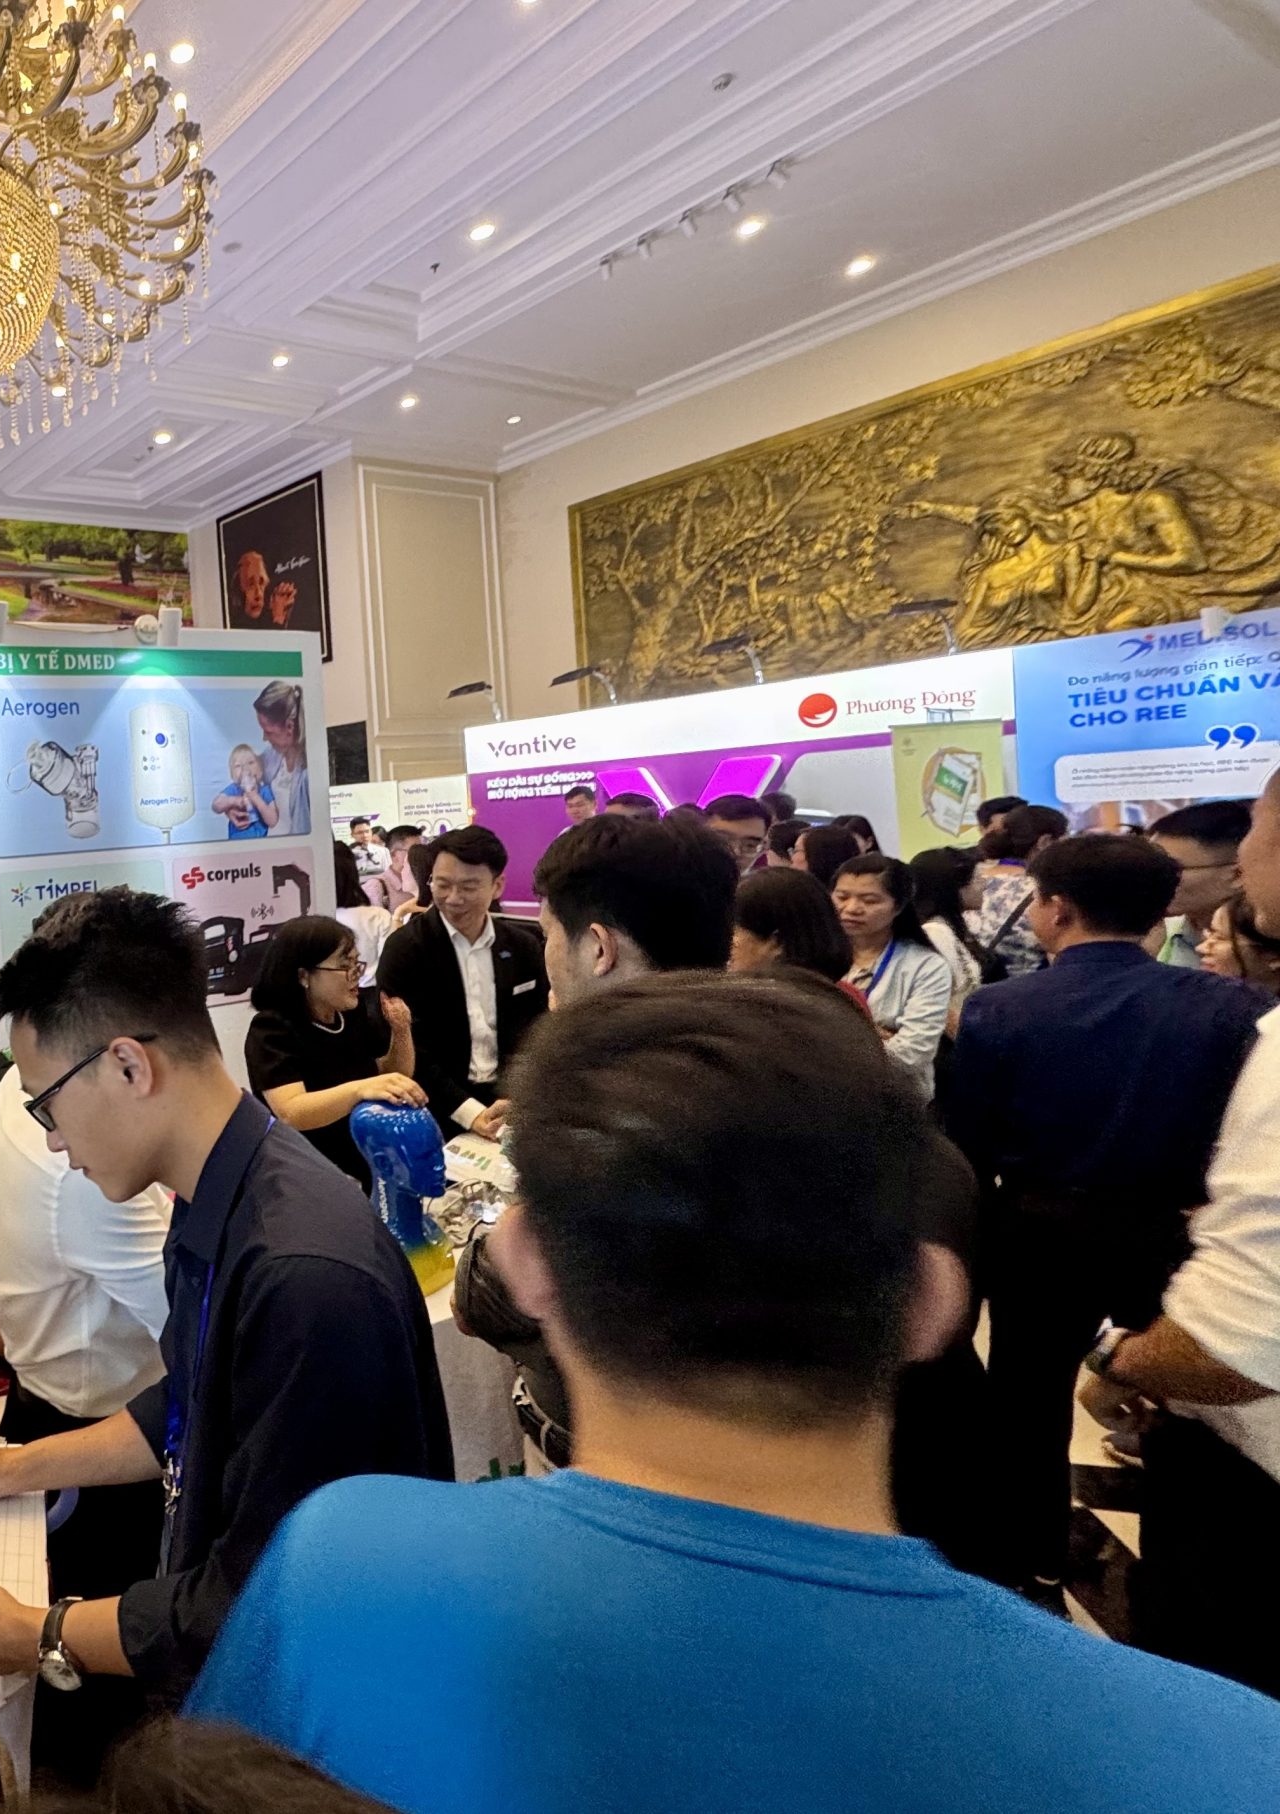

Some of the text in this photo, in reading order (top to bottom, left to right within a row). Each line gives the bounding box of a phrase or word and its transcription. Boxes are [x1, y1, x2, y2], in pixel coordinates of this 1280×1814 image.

[19, 653, 31, 670] Y
[35, 648, 60, 670] TẾ
[64, 654, 116, 670] DMED
[846, 697, 916, 715] Phương
[1067, 686, 1127, 707] TIÊU
[1, 697, 80, 718] Aerogen
[1069, 703, 1188, 728] CHO REE
[487, 734, 577, 757] Vantive
[140, 797, 169, 806] Aerogen
[207, 863, 262, 884] corpuls
